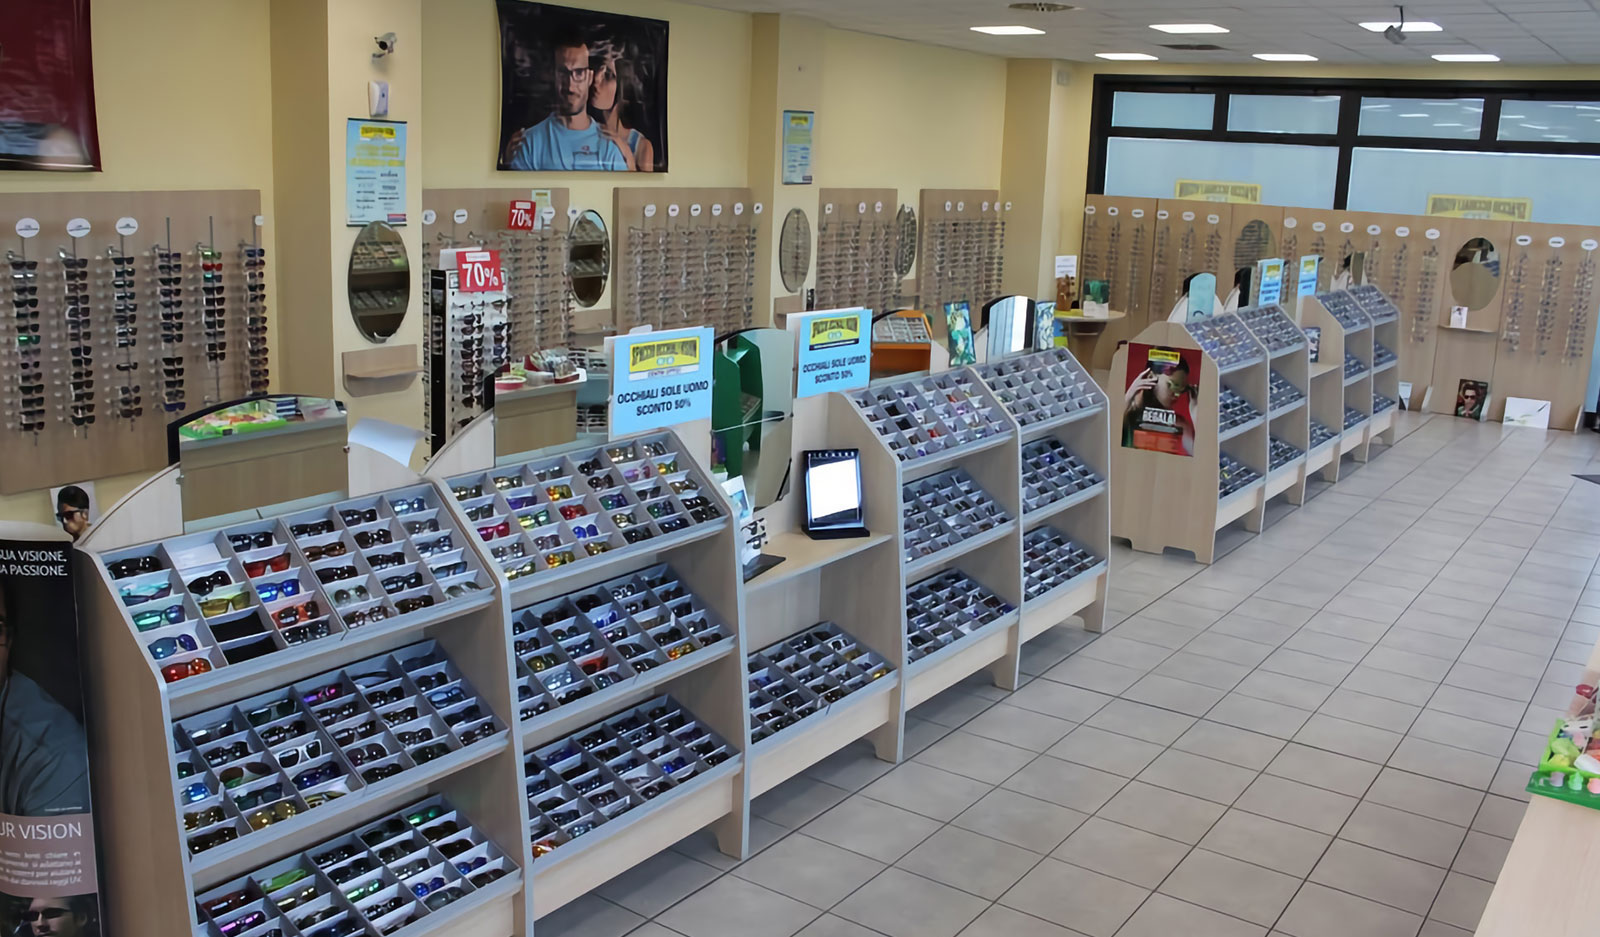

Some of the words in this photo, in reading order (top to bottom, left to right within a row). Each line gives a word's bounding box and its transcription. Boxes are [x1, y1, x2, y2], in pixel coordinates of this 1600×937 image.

[511, 209, 532, 227] 70%
[462, 263, 499, 288] 70%
[617, 389, 658, 404] OCCHIALI
[661, 384, 680, 397] SOLE
[683, 381, 709, 393] UOMO
[636, 401, 672, 416] SCONTO
[674, 399, 691, 409] 50%
[18, 822, 82, 840] VISION
